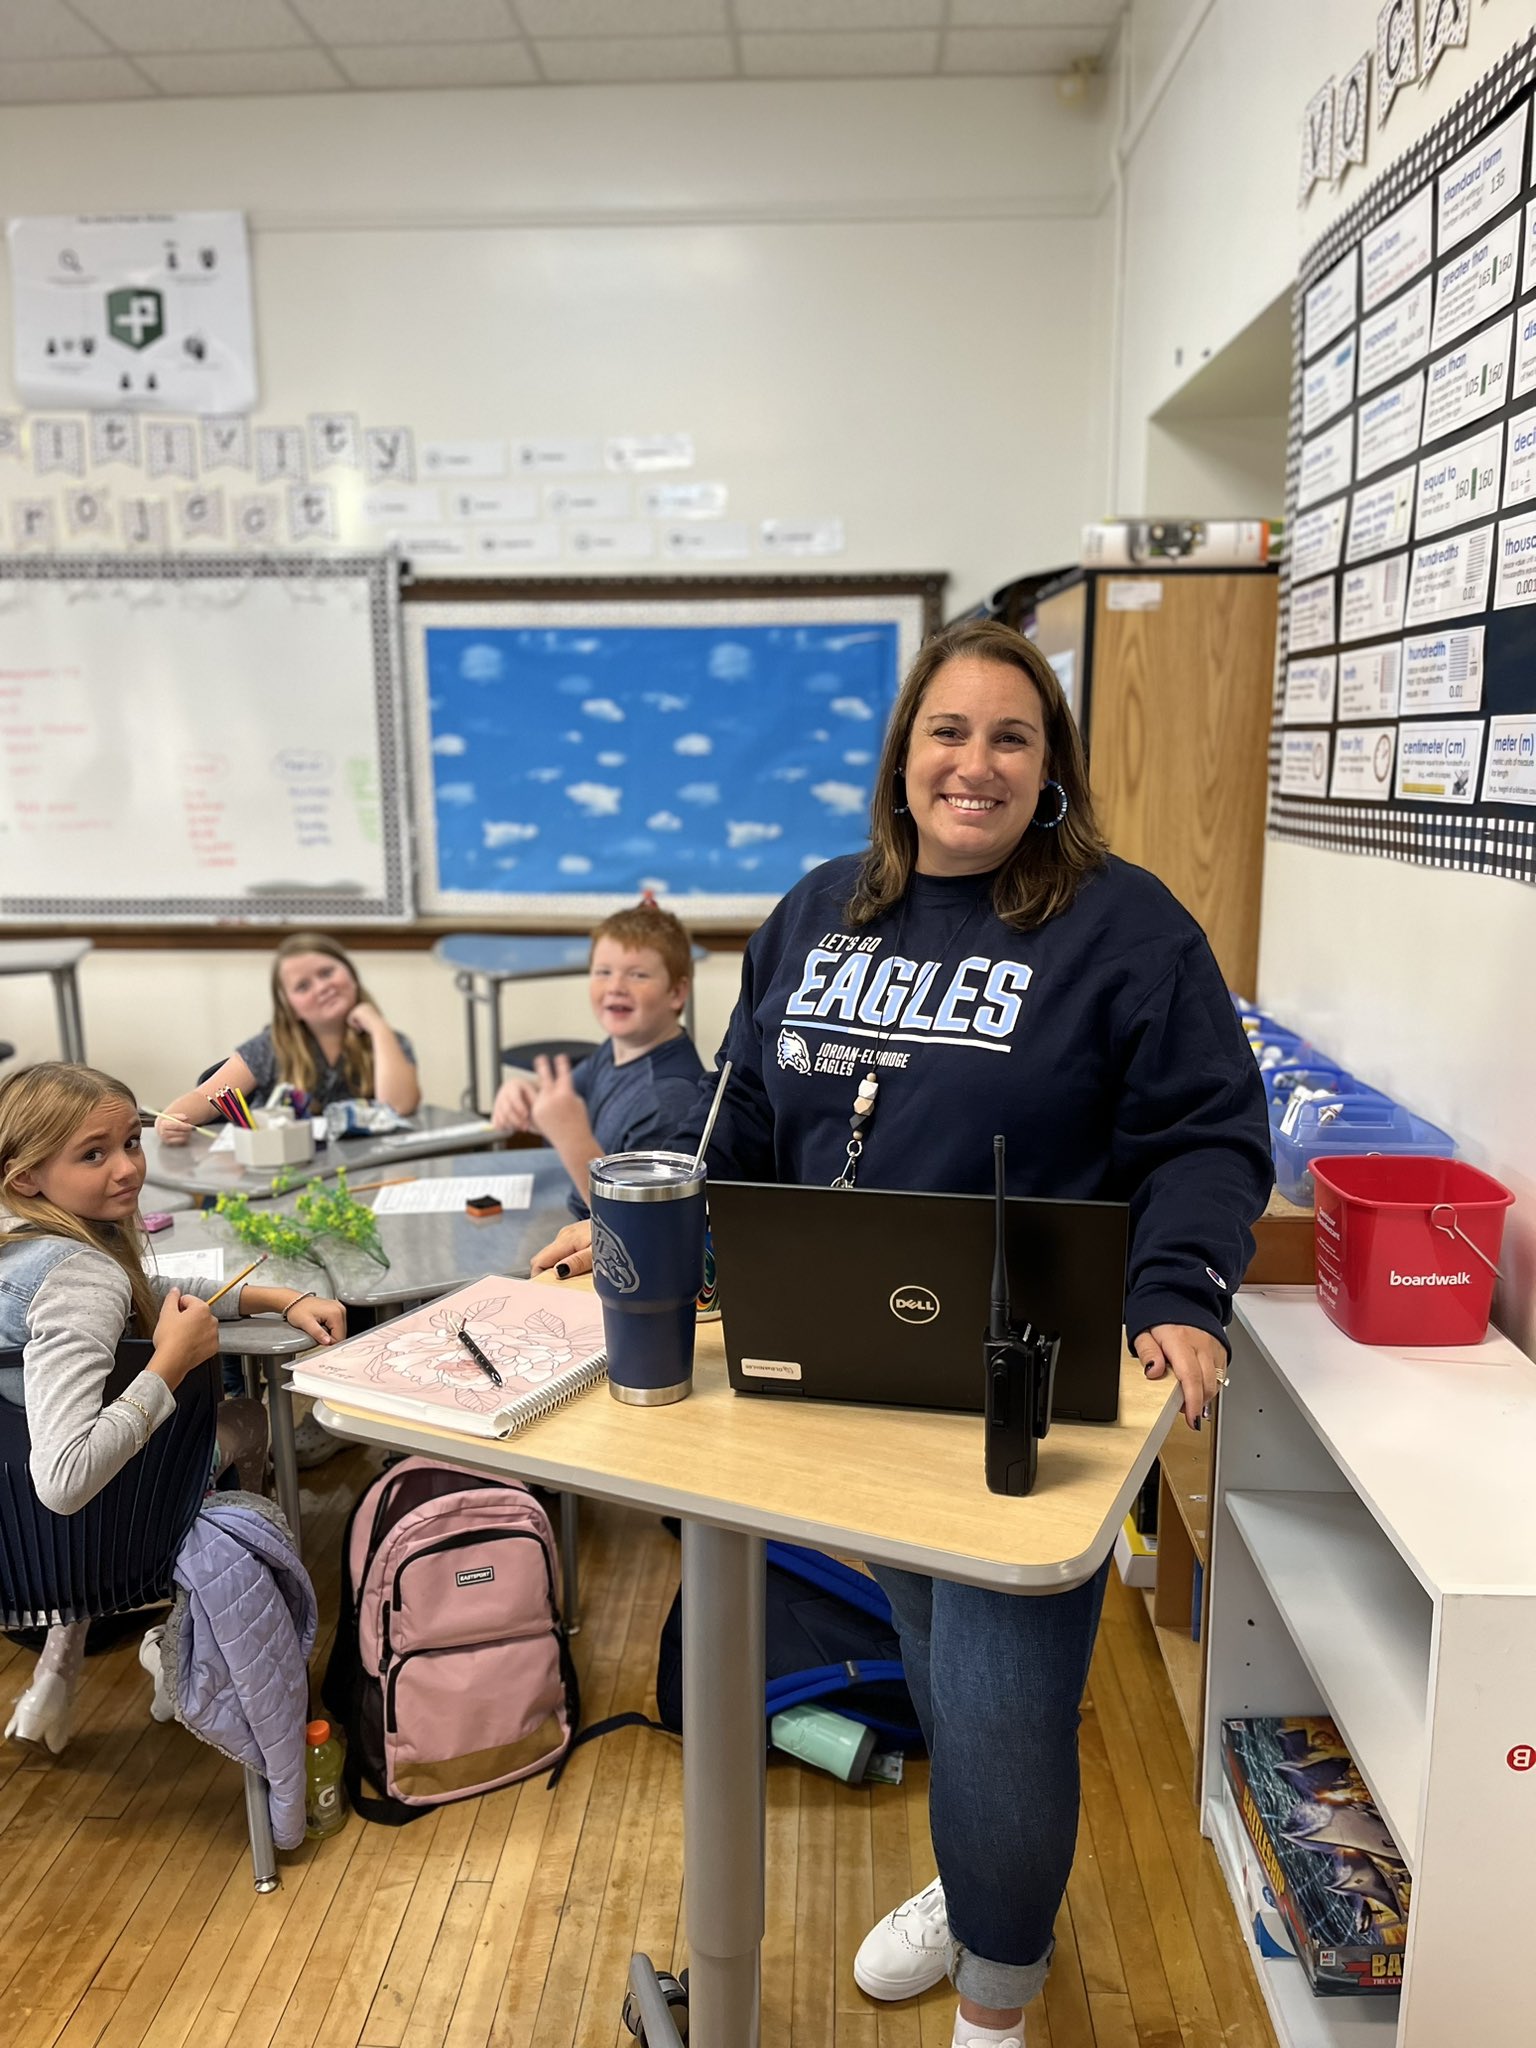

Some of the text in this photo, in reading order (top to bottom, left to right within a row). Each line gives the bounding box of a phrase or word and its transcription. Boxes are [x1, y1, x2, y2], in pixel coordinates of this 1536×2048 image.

[1490, 167, 1505, 195] 135
[1442, 258, 1471, 293] greater
[1498, 252, 1512, 276] 160
[1487, 362, 1503, 386] 160
[1423, 465, 1457, 492] equal to
[1455, 468, 1494, 501] 160 160
[1448, 684, 1463, 699] 0.01
[1402, 736, 1466, 759] centimeter (cm)
[1493, 732, 1534, 757] meter (m)
[818, 932, 883, 953] LET'S GO
[785, 948, 1034, 1038] EAGLES
[814, 1056, 855, 1077] EAGLES
[1389, 1270, 1471, 1287] boardwalk
[895, 1298, 935, 1311] DELL
